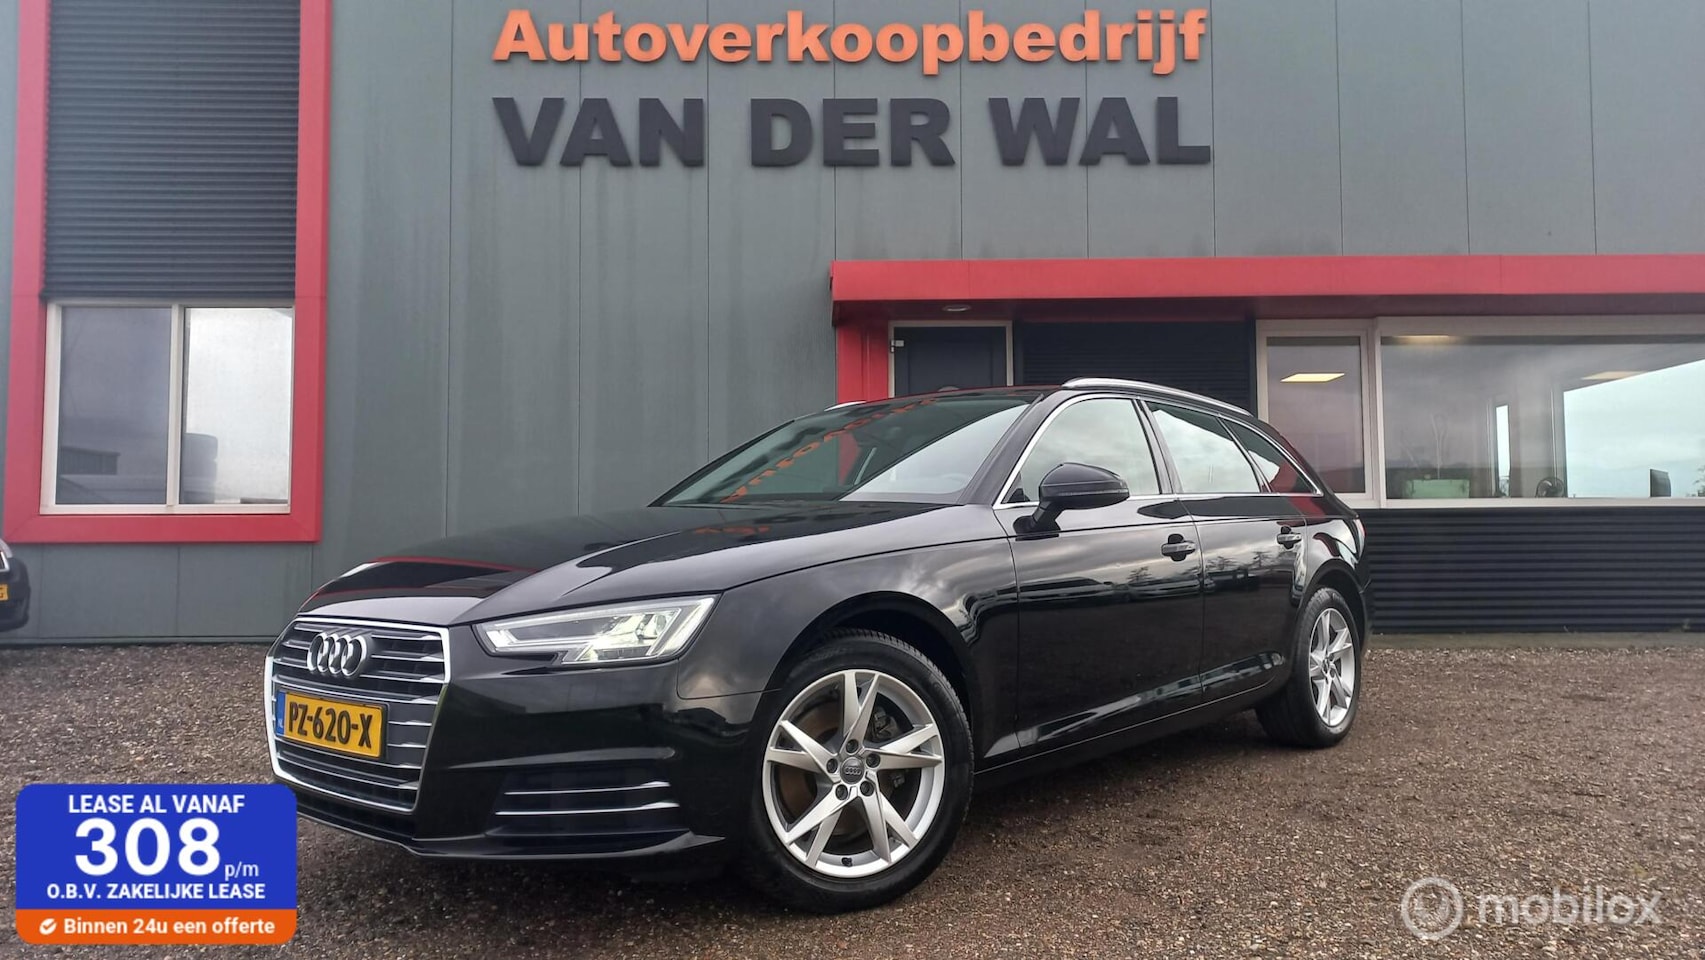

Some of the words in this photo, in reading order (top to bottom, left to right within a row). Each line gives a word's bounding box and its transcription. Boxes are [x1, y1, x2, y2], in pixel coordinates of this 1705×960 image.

[493, 9, 1207, 76] Autoverkoopbedrijf
[493, 97, 705, 167] VAN
[750, 97, 956, 167] DER
[988, 96, 1212, 167] WAL
[288, 701, 373, 749] PZ-620-X
